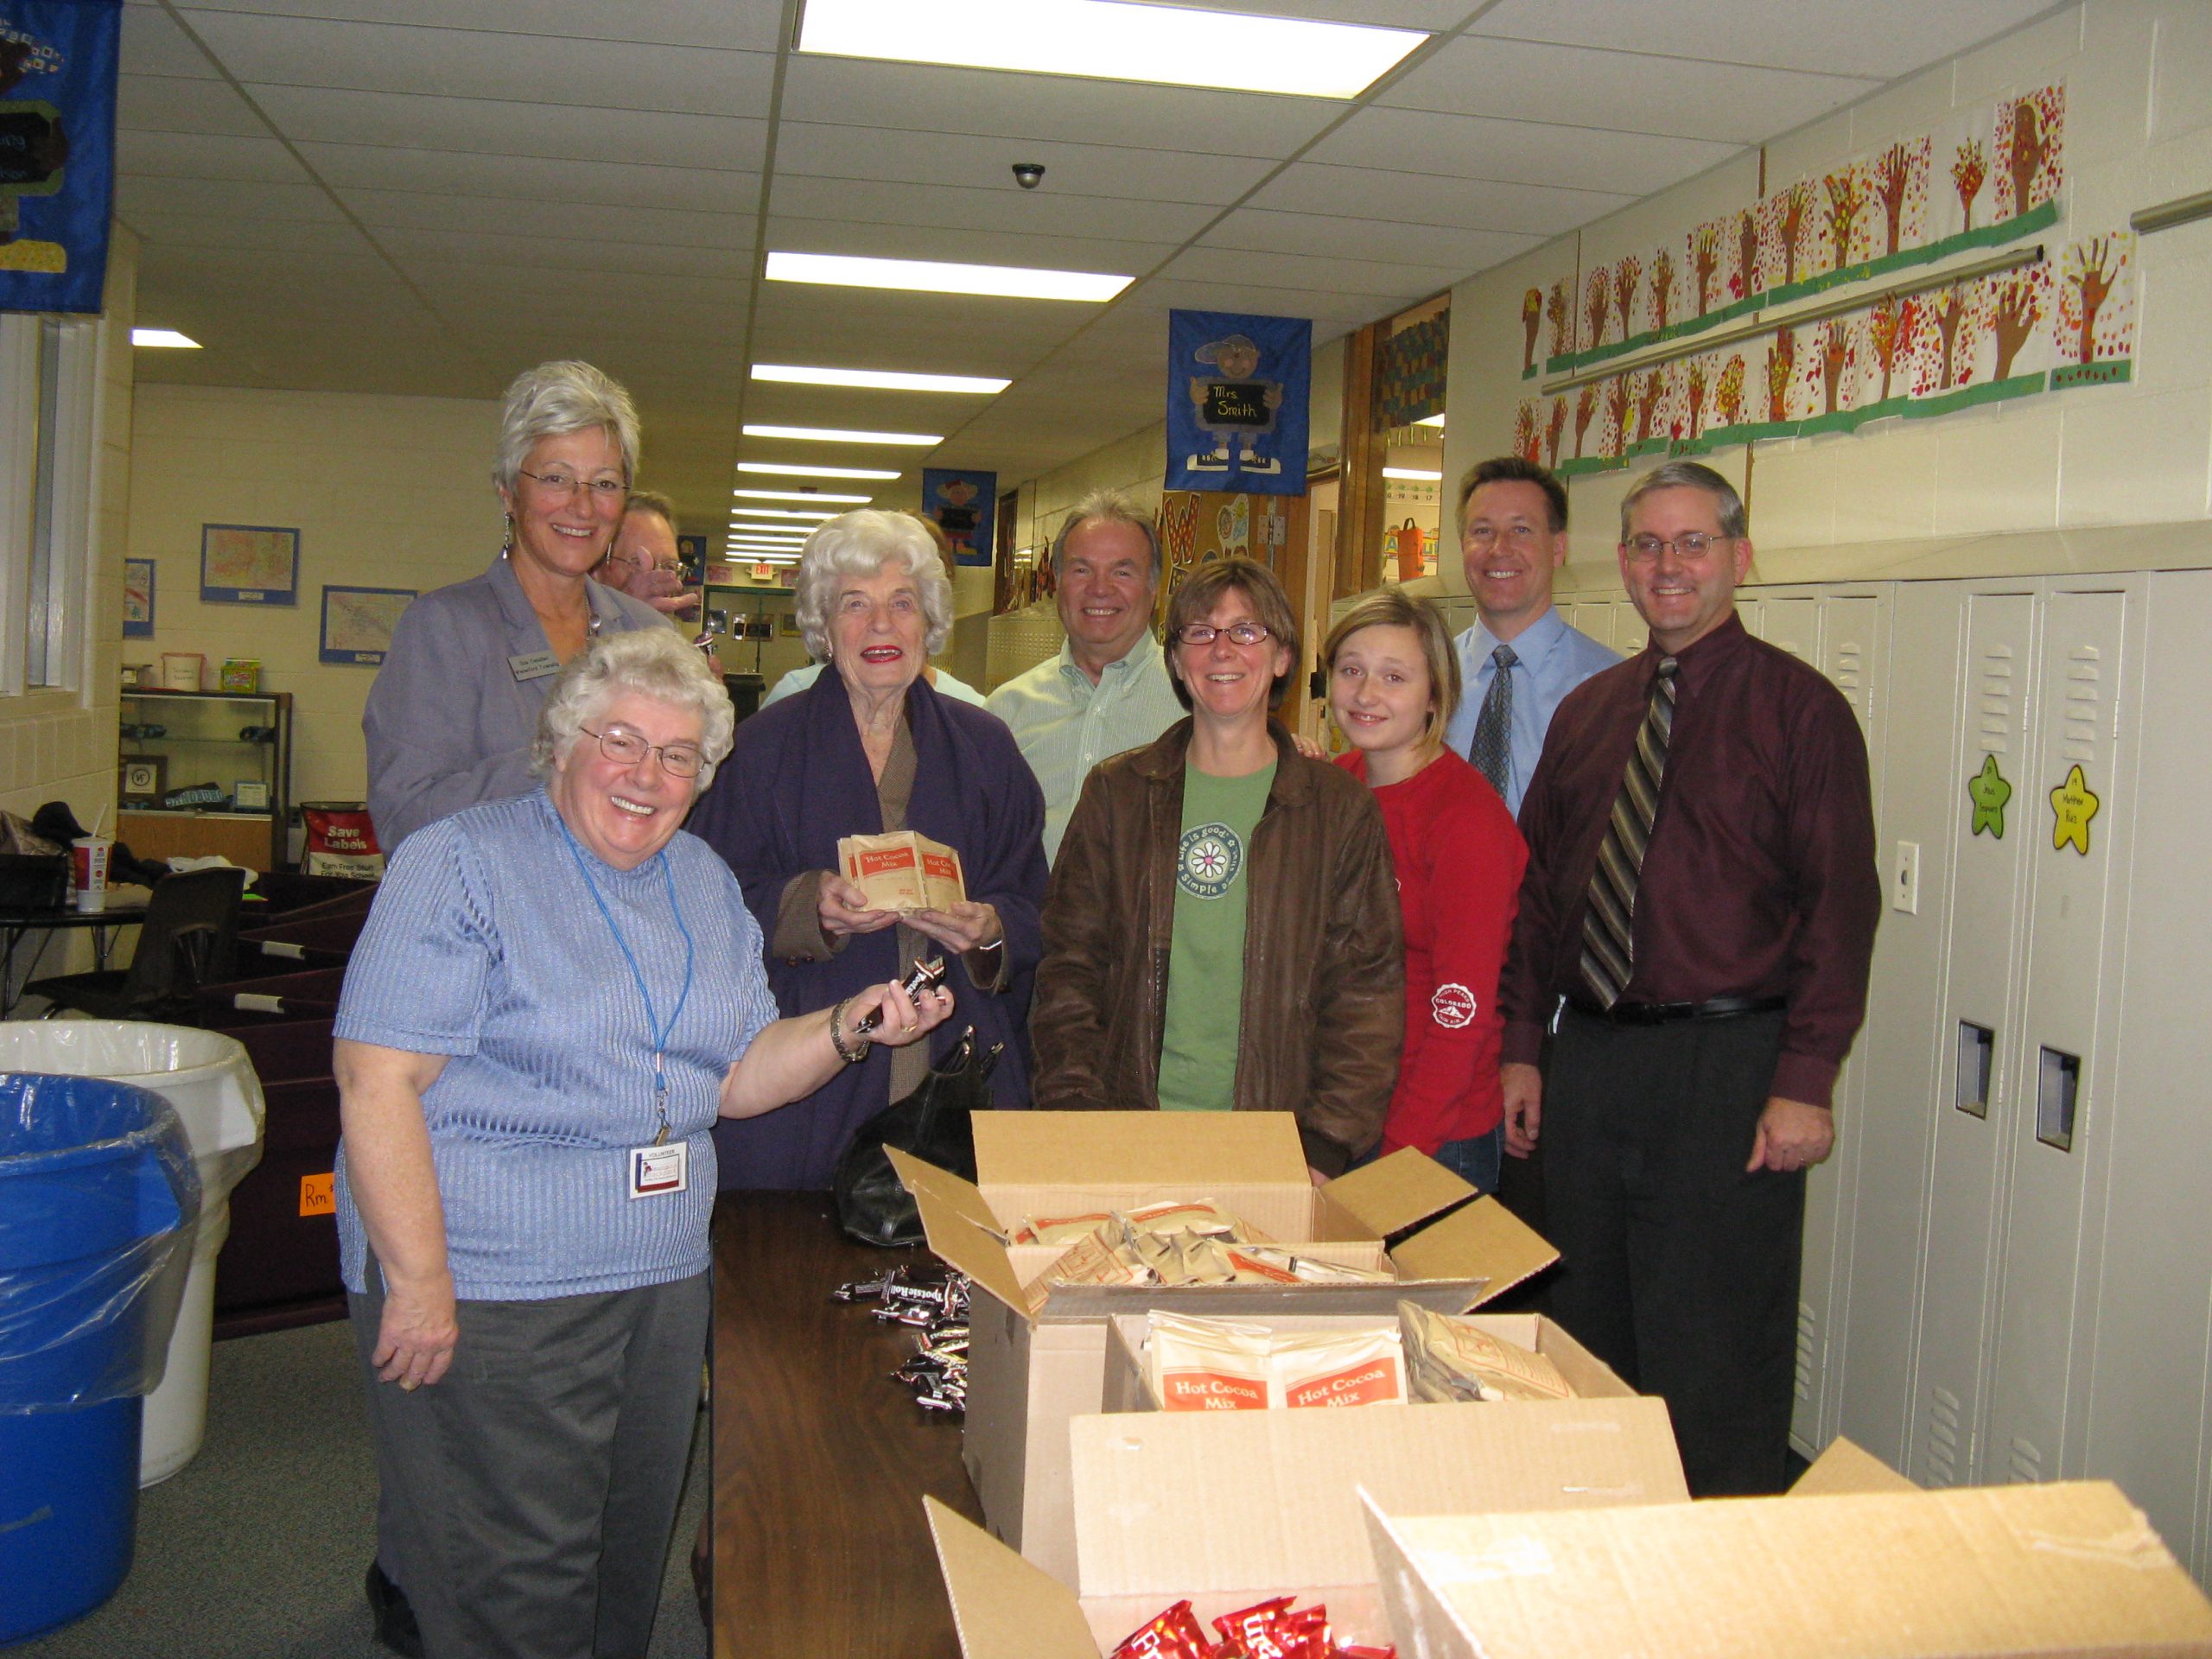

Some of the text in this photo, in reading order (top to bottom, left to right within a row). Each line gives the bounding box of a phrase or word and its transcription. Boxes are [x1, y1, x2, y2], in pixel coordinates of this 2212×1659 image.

[1213, 385, 1238, 399] Mrs
[1217, 400, 1258, 417] Smith
[755, 563, 769, 575] EXIT
[327, 825, 360, 837] Save
[324, 838, 368, 849] Labels
[865, 850, 910, 863] Hot Cocoa
[1435, 997, 1471, 1009] COLORADO
[648, 1149, 676, 1158] VOLUNTEER
[305, 1184, 327, 1207] Rm
[890, 1284, 910, 1298] Roll
[908, 1287, 944, 1303] Tootsie
[1175, 1381, 1259, 1400] Hot Cocoa
[1297, 1369, 1387, 1407] Hot Cocoa
[1205, 1398, 1237, 1410] Mix
[1326, 1391, 1362, 1408] Mix
